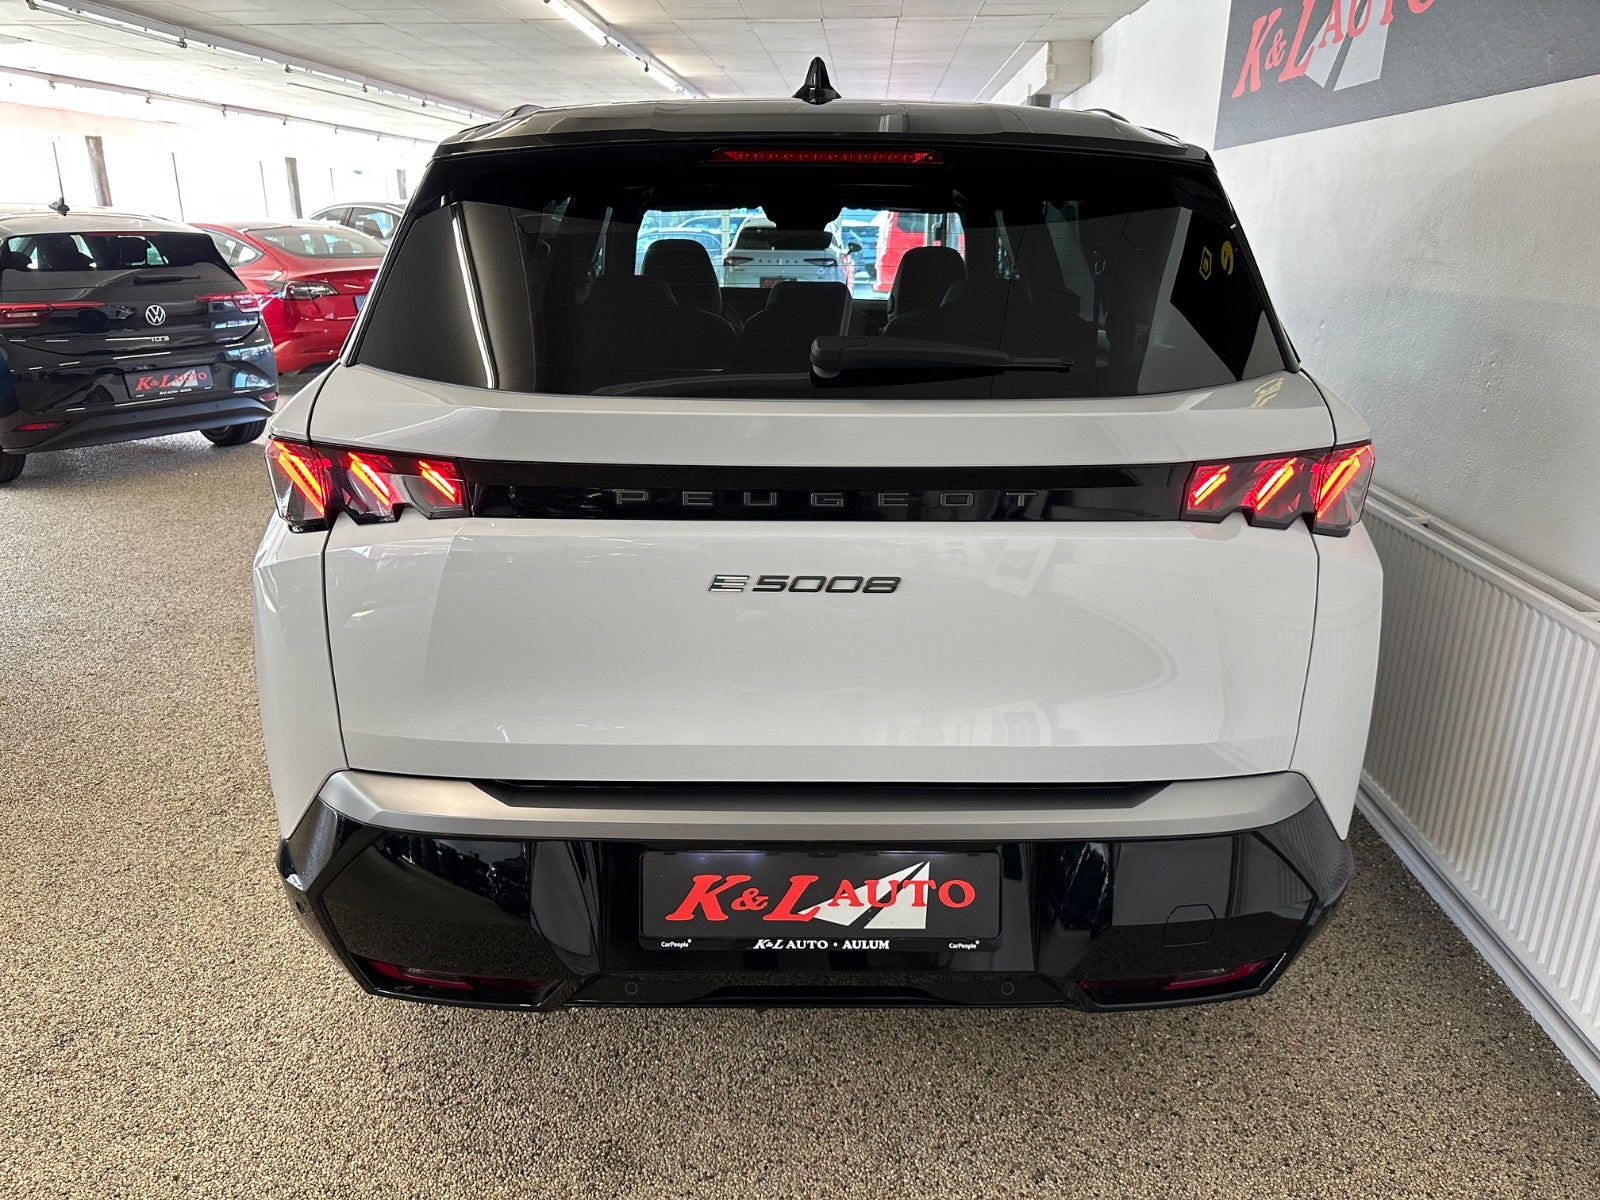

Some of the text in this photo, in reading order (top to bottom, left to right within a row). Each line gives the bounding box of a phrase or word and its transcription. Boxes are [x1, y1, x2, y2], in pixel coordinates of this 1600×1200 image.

[1232, 0, 1434, 98] K&L AU
[616, 490, 1038, 508] PEUGEOT
[708, 574, 902, 594] E 5008
[665, 874, 977, 922] K&L AUTO
[786, 940, 829, 949] AUTO
[842, 940, 890, 949] AULUM
